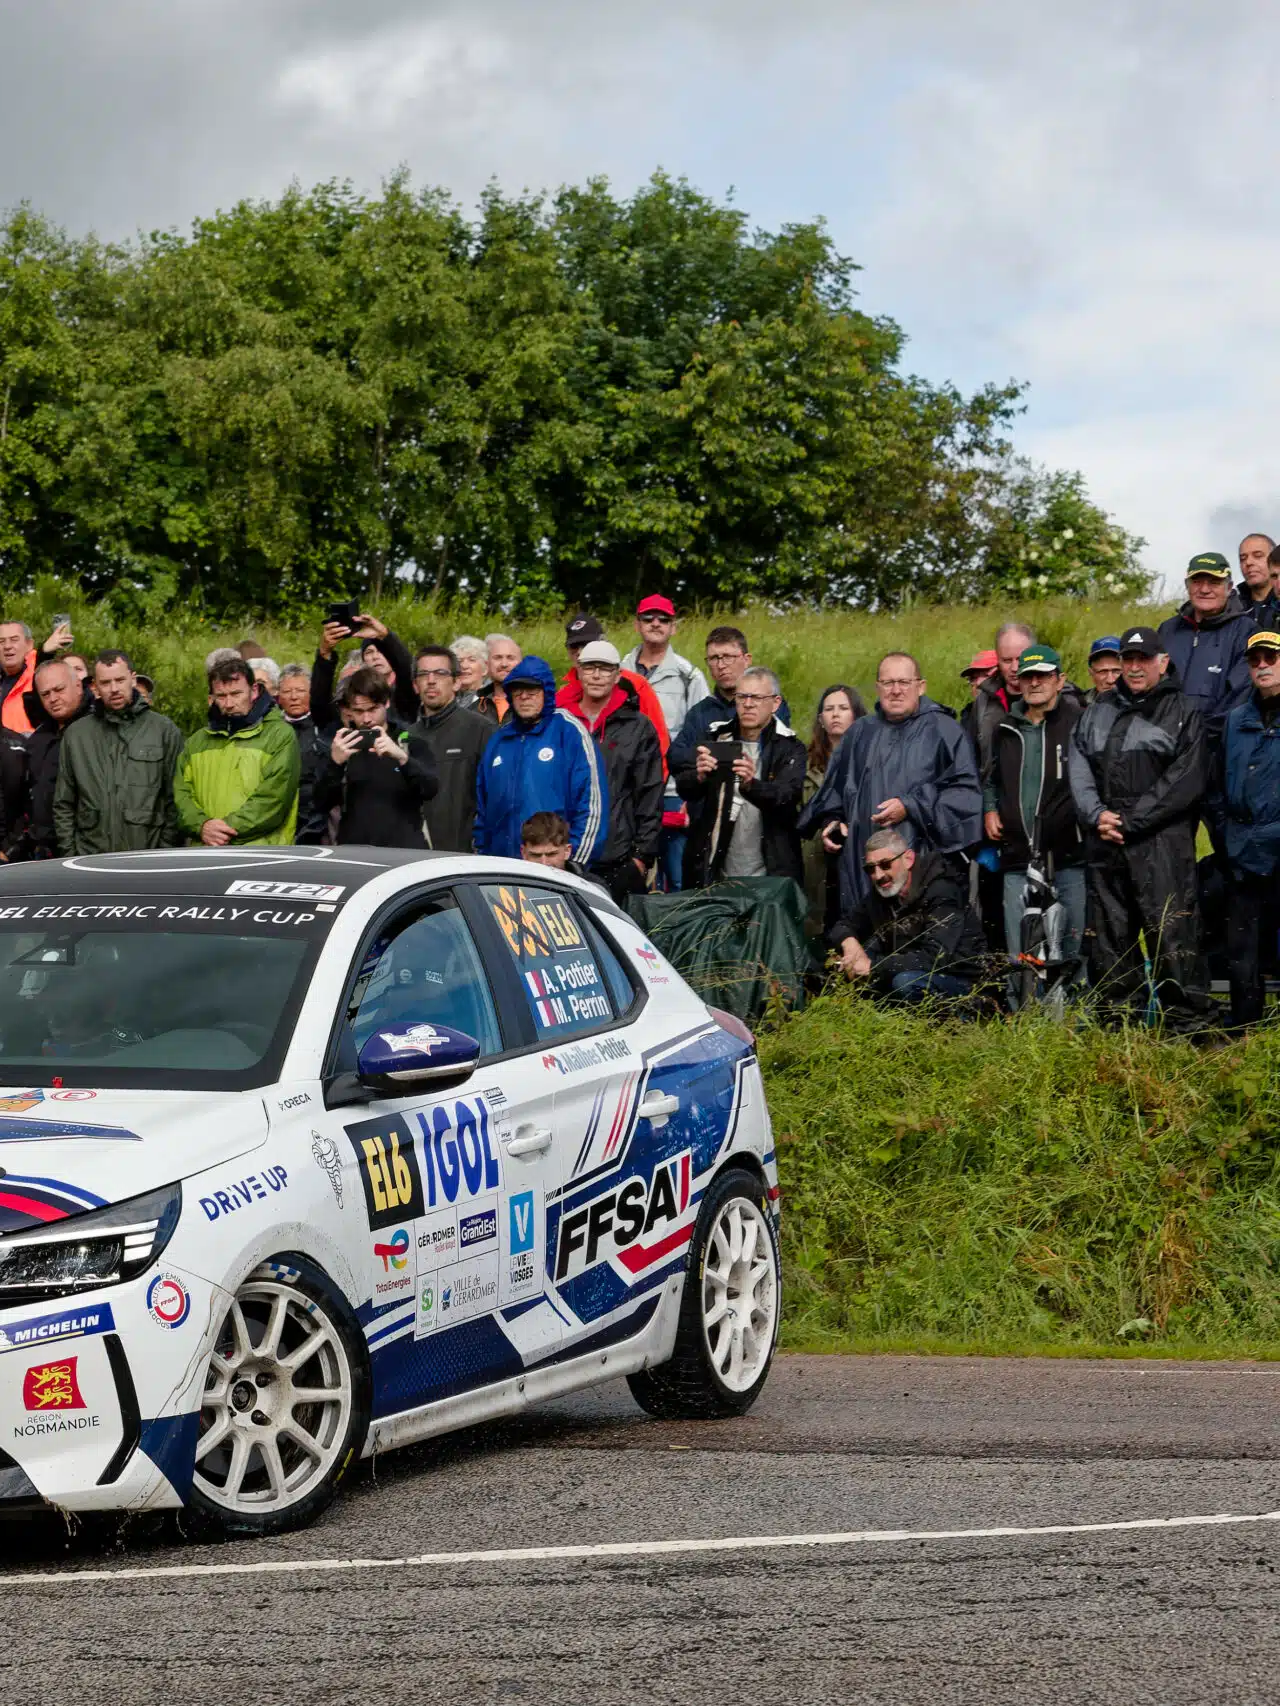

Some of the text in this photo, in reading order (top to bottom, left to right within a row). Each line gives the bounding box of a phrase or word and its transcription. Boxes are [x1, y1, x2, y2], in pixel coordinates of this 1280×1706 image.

[32, 906, 157, 920] ELECTRIC
[158, 906, 251, 923] RALLY
[253, 909, 316, 925] CUP
[537, 903, 580, 946] EL6
[540, 960, 599, 995] A. Pottier
[553, 990, 610, 1024] M. Perrin
[284, 1093, 312, 1109] ORECA
[416, 1097, 499, 1207] IGOL
[261, 1165, 288, 1192] UP
[360, 1132, 412, 1212] EL6
[556, 1165, 678, 1281] FFSA
[376, 1276, 411, 1293] TotalEnergies
[453, 1276, 471, 1293] VILLE
[510, 1265, 533, 1284] VOSGES
[15, 1314, 100, 1343] MICHELIN
[14, 1415, 100, 1437] NORMANDIE
[27, 1413, 62, 1424] RÉGION
